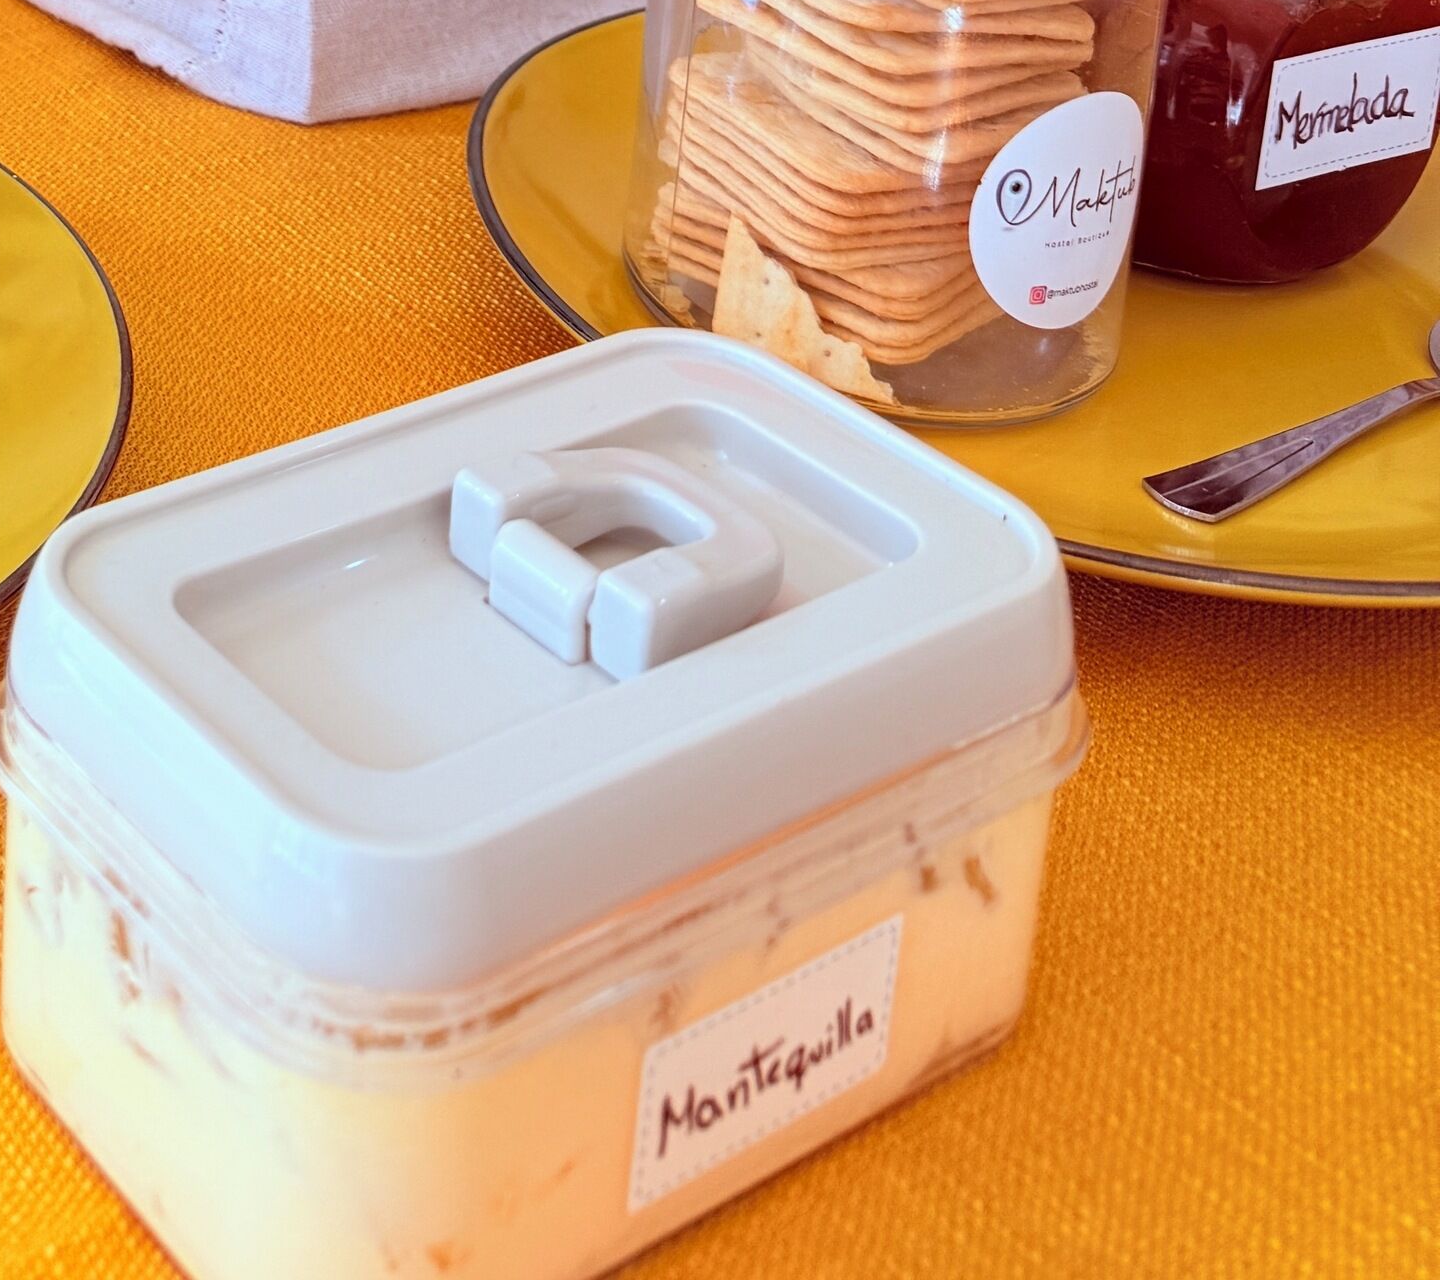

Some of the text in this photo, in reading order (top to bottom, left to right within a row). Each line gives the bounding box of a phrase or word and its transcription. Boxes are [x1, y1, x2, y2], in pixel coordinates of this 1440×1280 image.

[1273, 72, 1415, 150] Mermelada
[1014, 155, 1137, 228] Maktub
[656, 996, 874, 1160] Mantequilla
